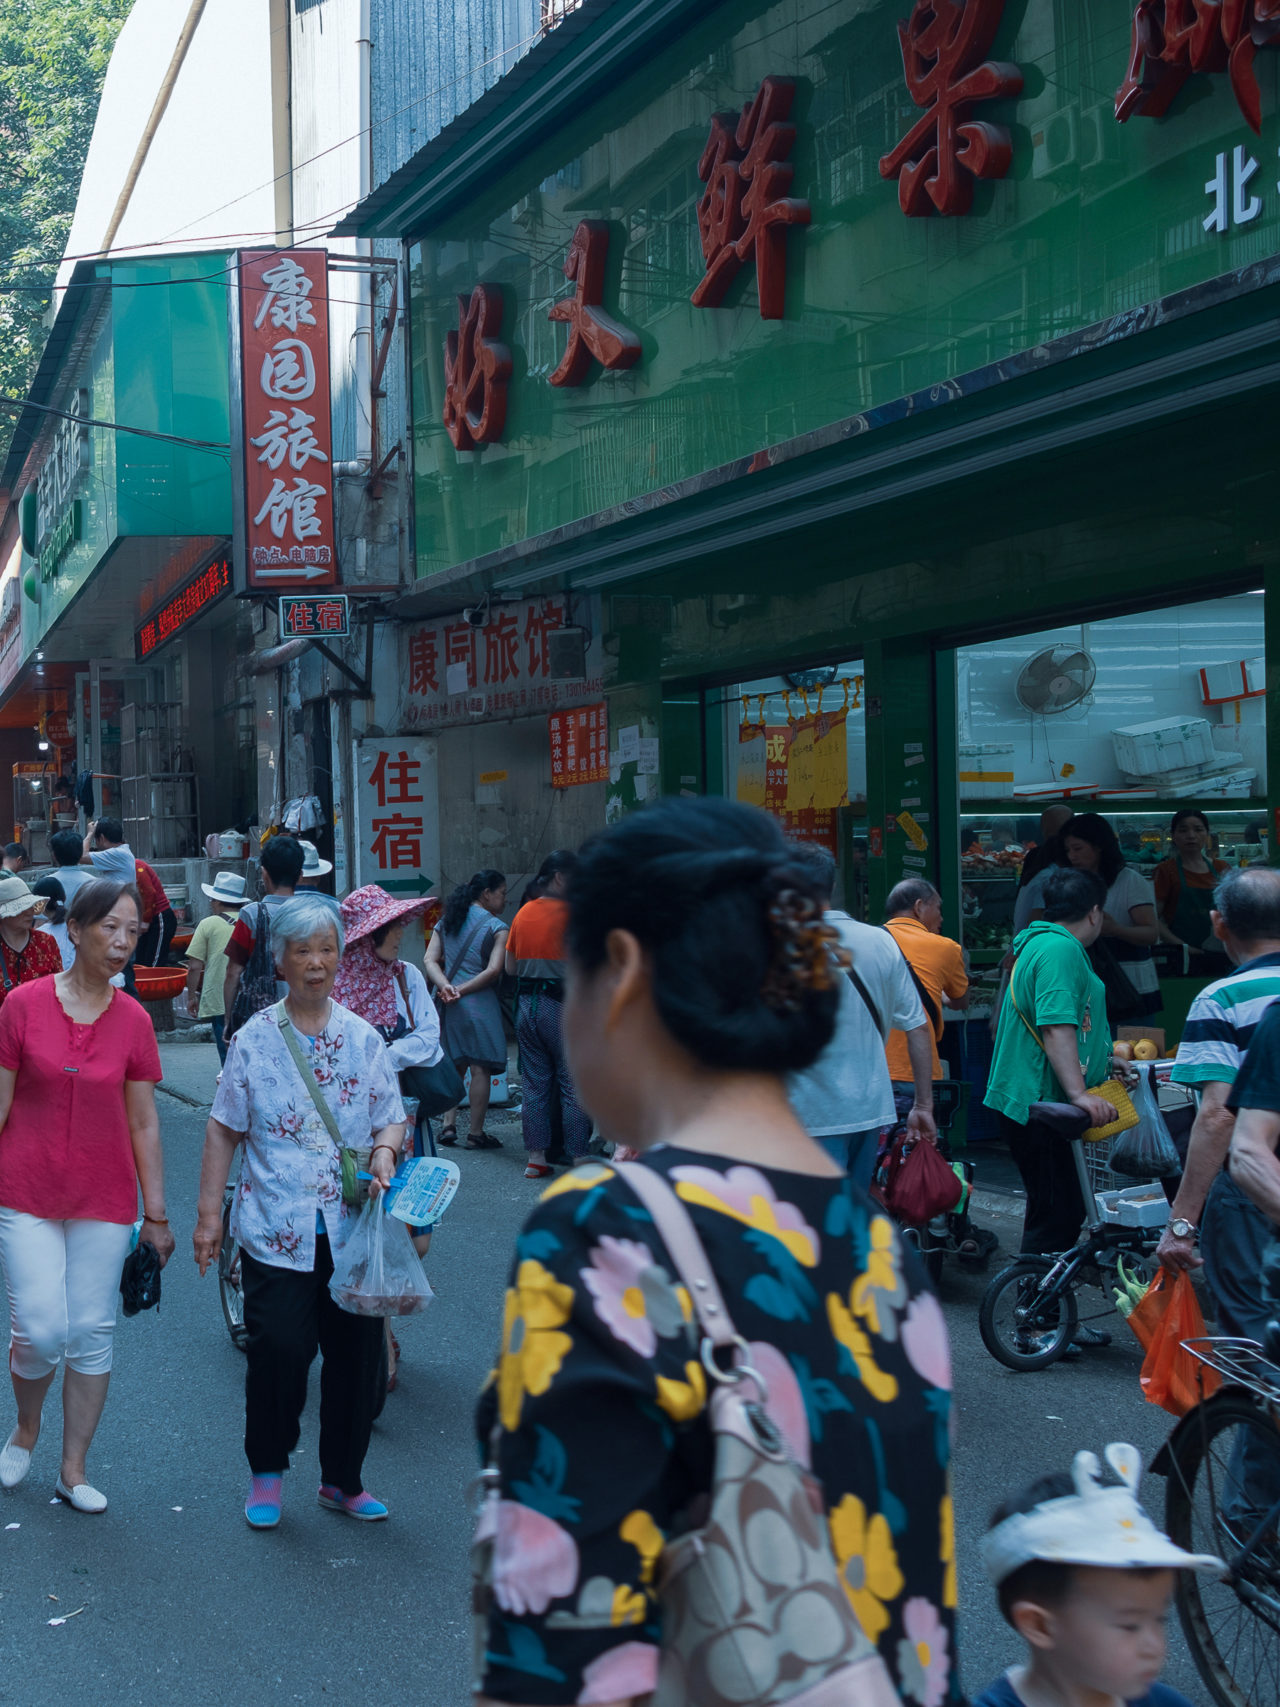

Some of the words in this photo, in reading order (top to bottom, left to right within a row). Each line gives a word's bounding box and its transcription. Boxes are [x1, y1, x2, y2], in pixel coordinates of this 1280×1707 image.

[1202, 145, 1280, 232] 北
[254, 257, 328, 541] 康园旅馆
[287, 602, 343, 632] 住宿
[550, 717, 562, 773] 原汤水饺
[368, 751, 424, 869] 住宿
